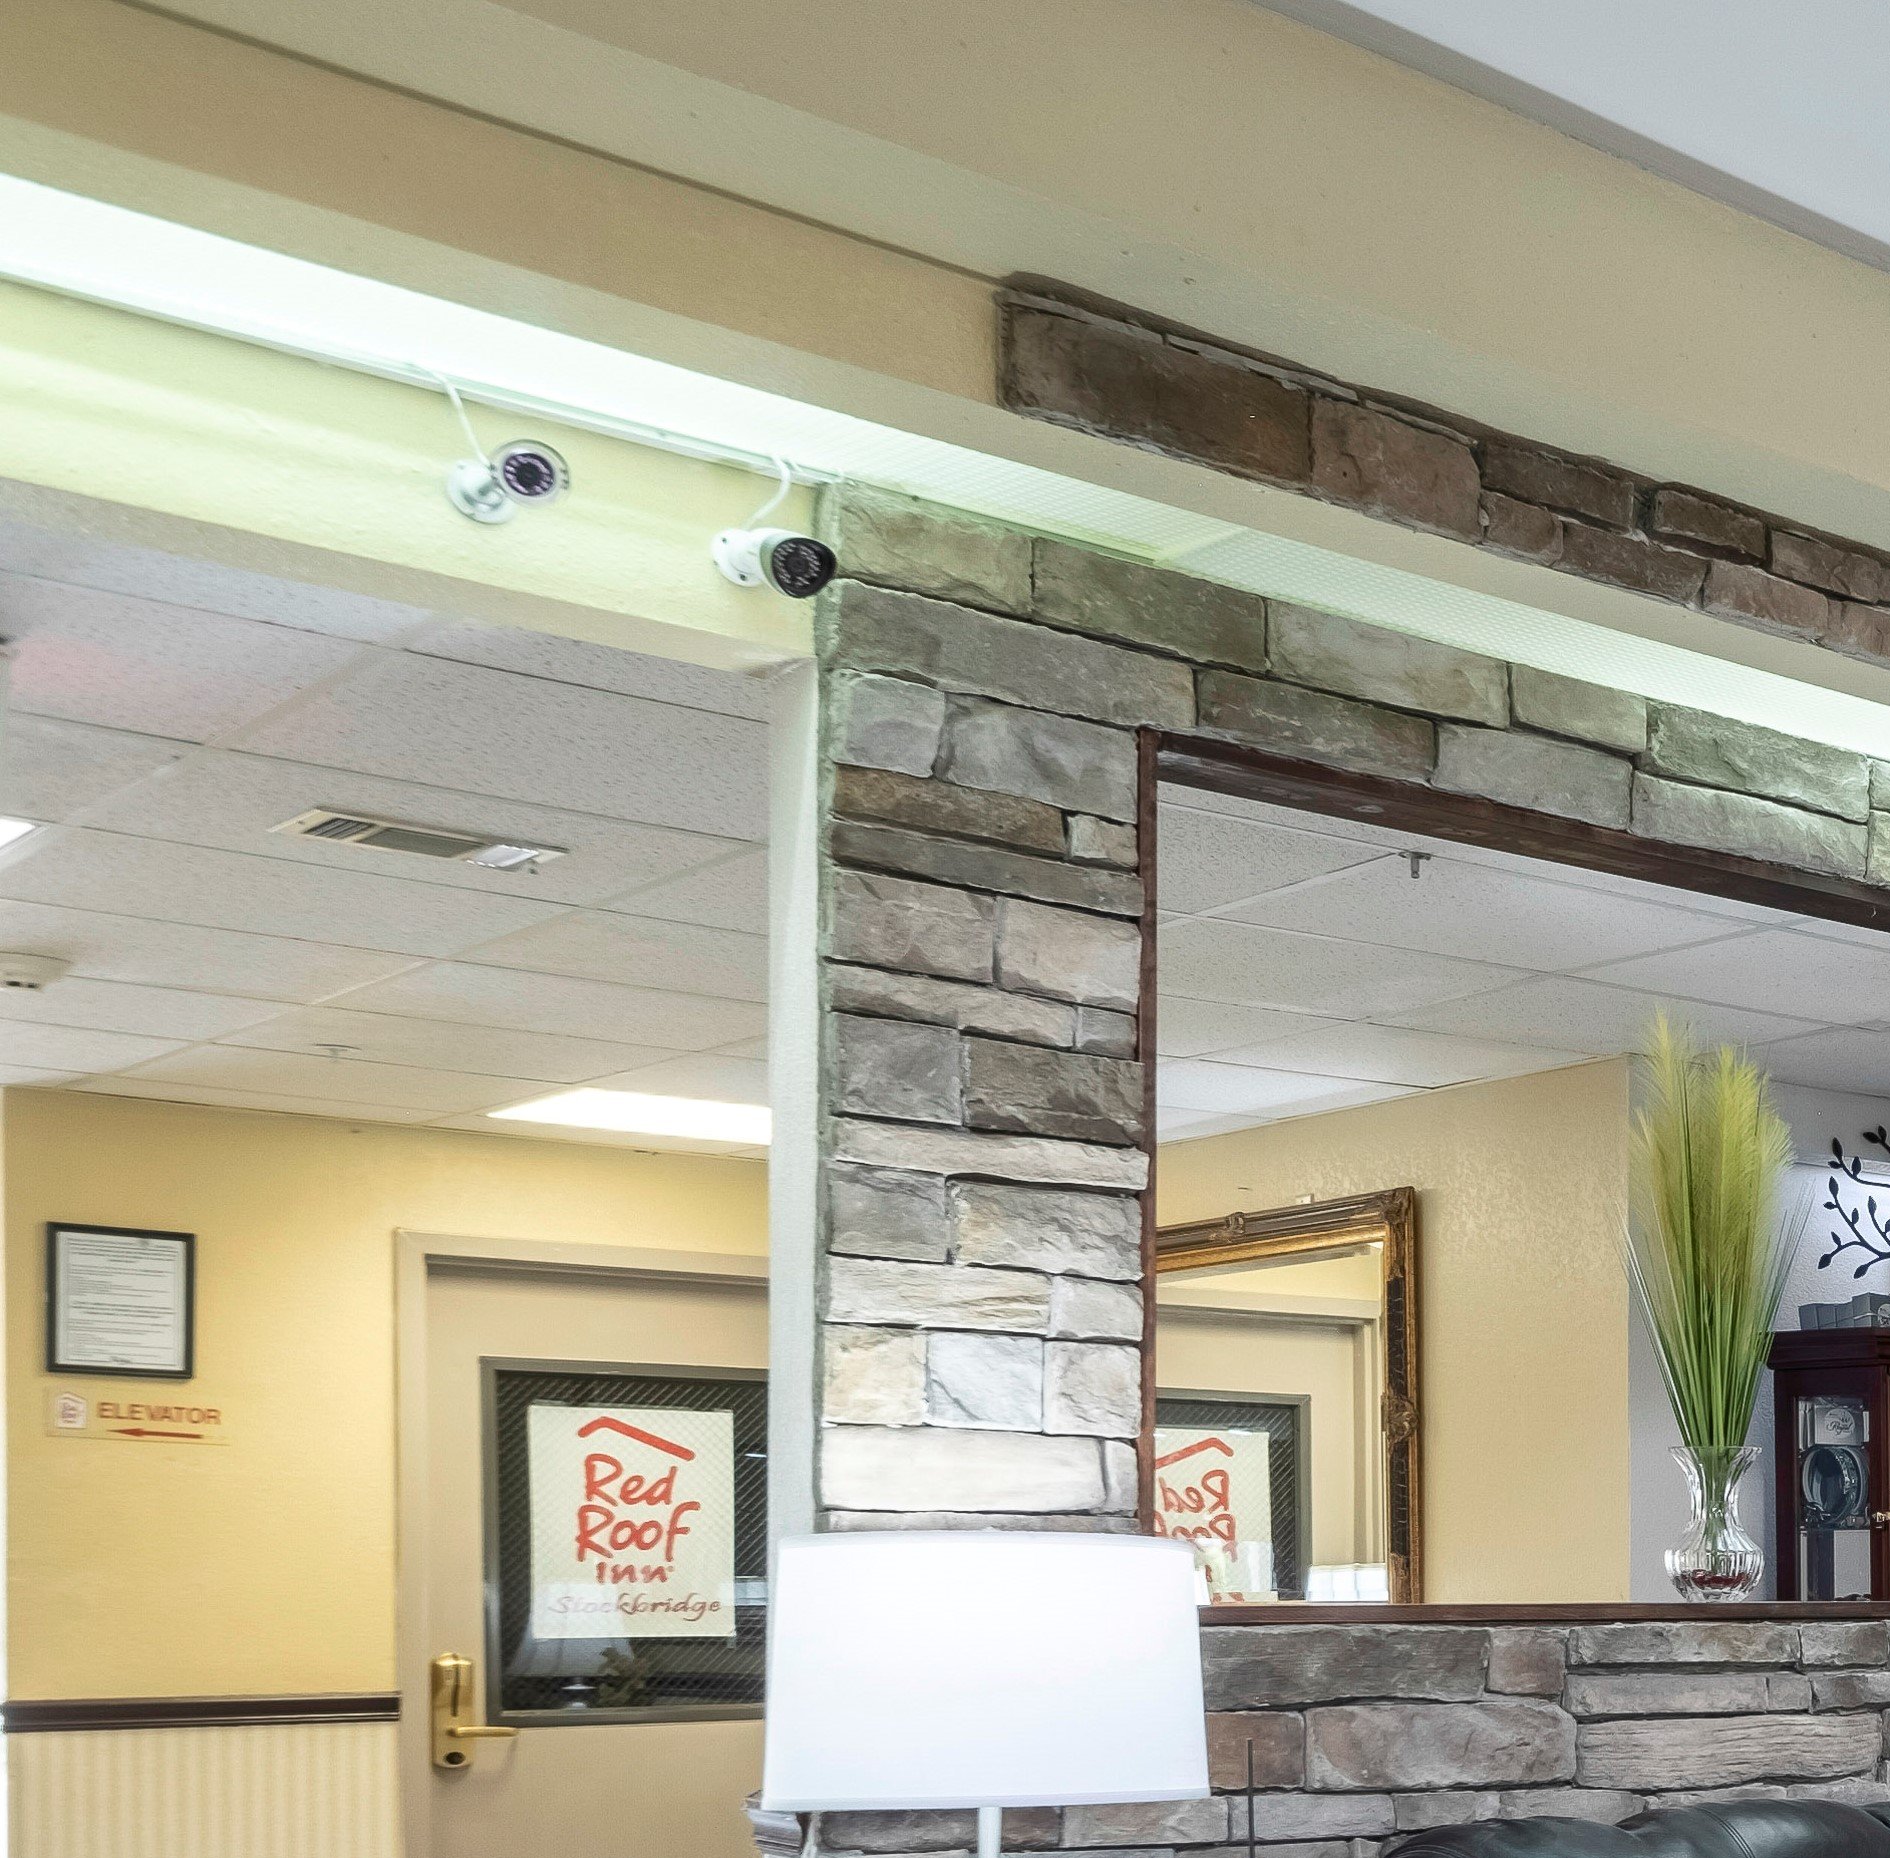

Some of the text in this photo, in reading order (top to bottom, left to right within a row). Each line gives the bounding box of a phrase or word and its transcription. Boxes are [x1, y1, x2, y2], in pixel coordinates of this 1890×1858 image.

[96, 1401, 222, 1425] ELEVATOR
[584, 1453, 678, 1507] Red
[575, 1501, 701, 1562] Roof
